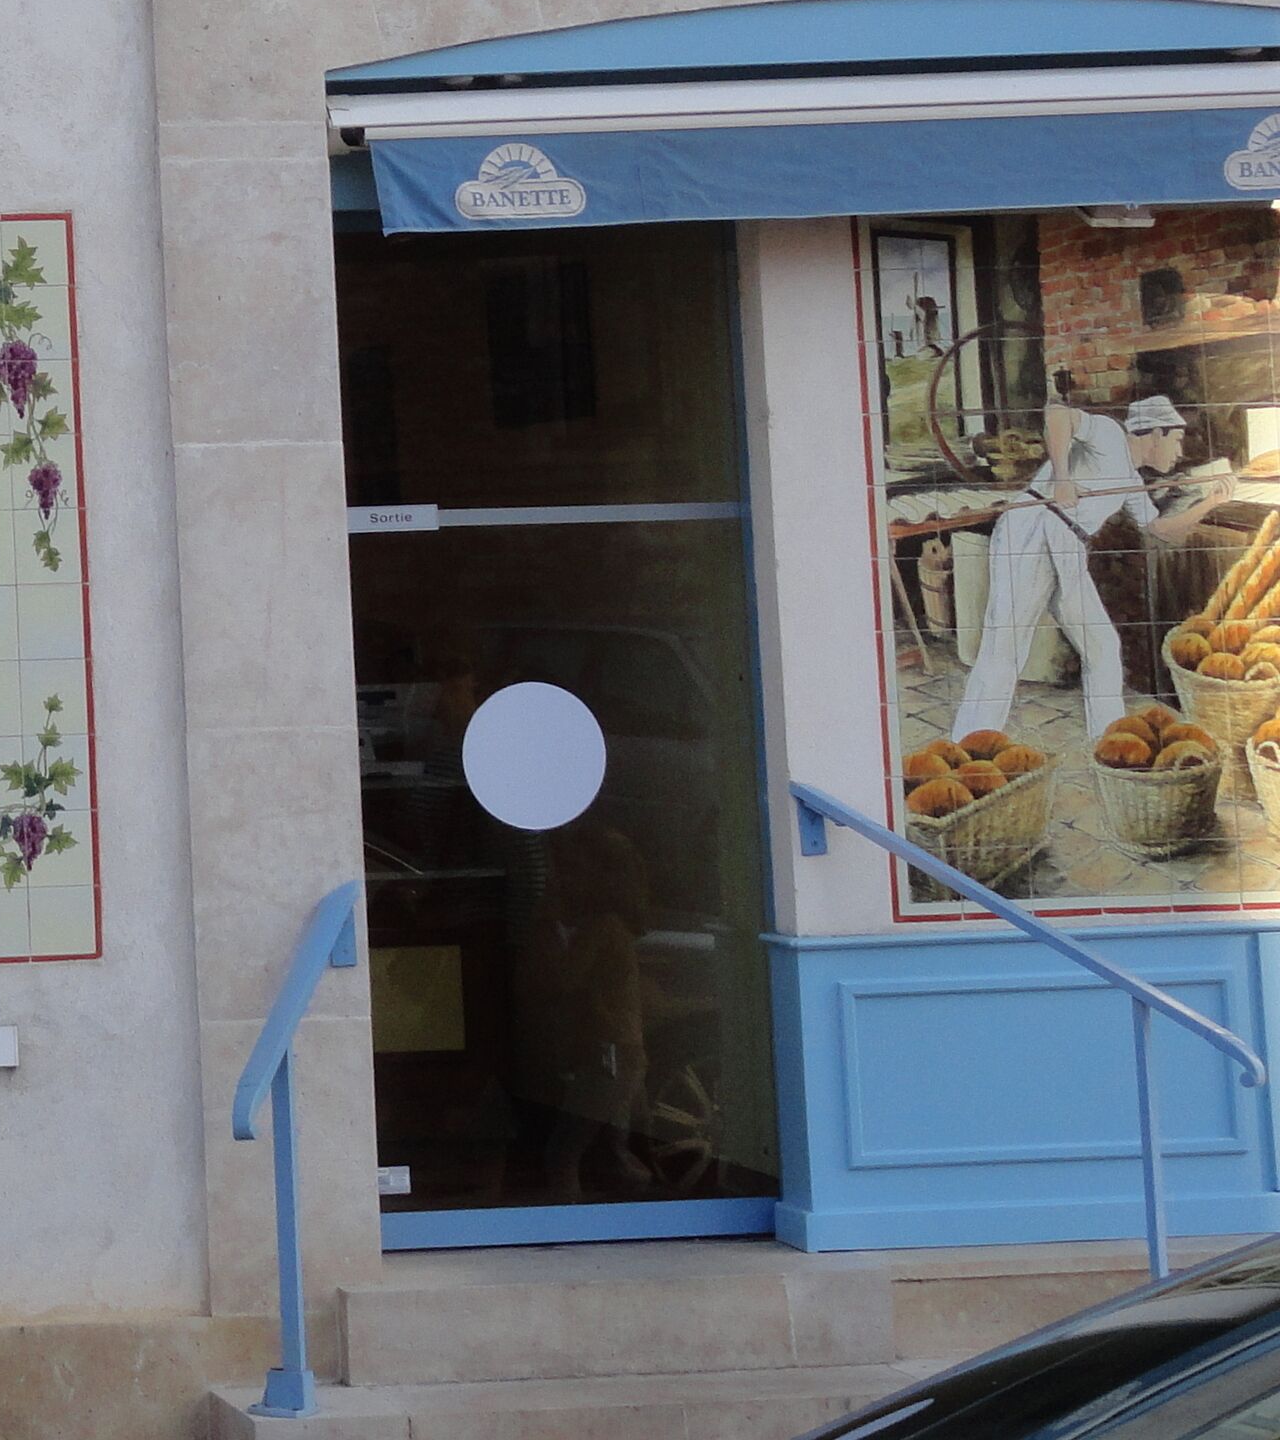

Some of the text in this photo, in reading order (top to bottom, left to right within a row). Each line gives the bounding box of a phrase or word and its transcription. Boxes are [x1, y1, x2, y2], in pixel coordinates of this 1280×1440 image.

[1239, 161, 1280, 178] BAN
[471, 188, 571, 209] BANETTE
[369, 511, 413, 524] Sortie
